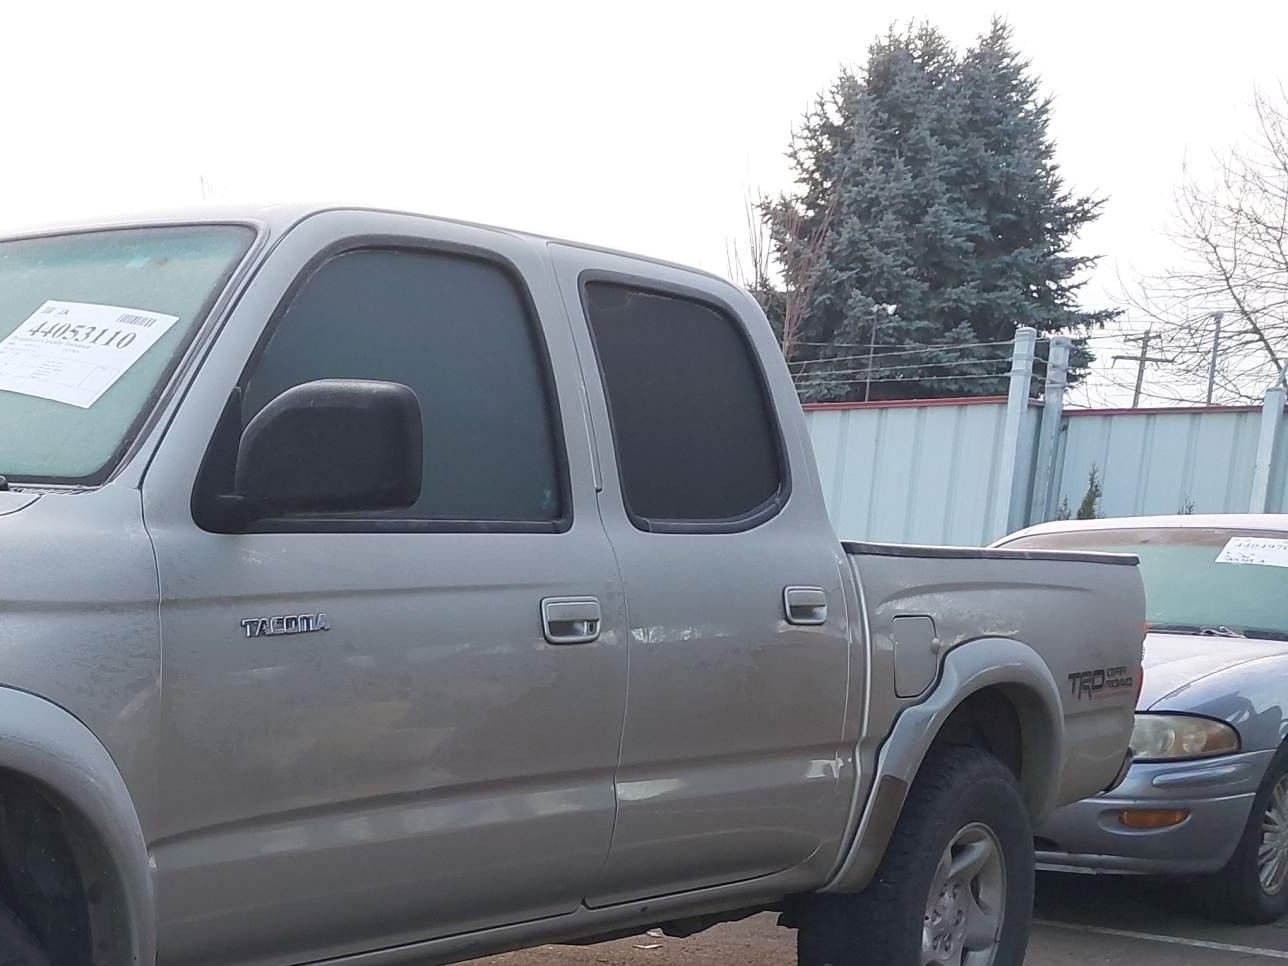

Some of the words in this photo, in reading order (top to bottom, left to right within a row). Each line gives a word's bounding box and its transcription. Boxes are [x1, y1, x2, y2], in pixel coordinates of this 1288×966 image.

[28, 320, 138, 350] 44053110
[241, 613, 330, 637] TACOMA
[1067, 669, 1105, 700] TRD
